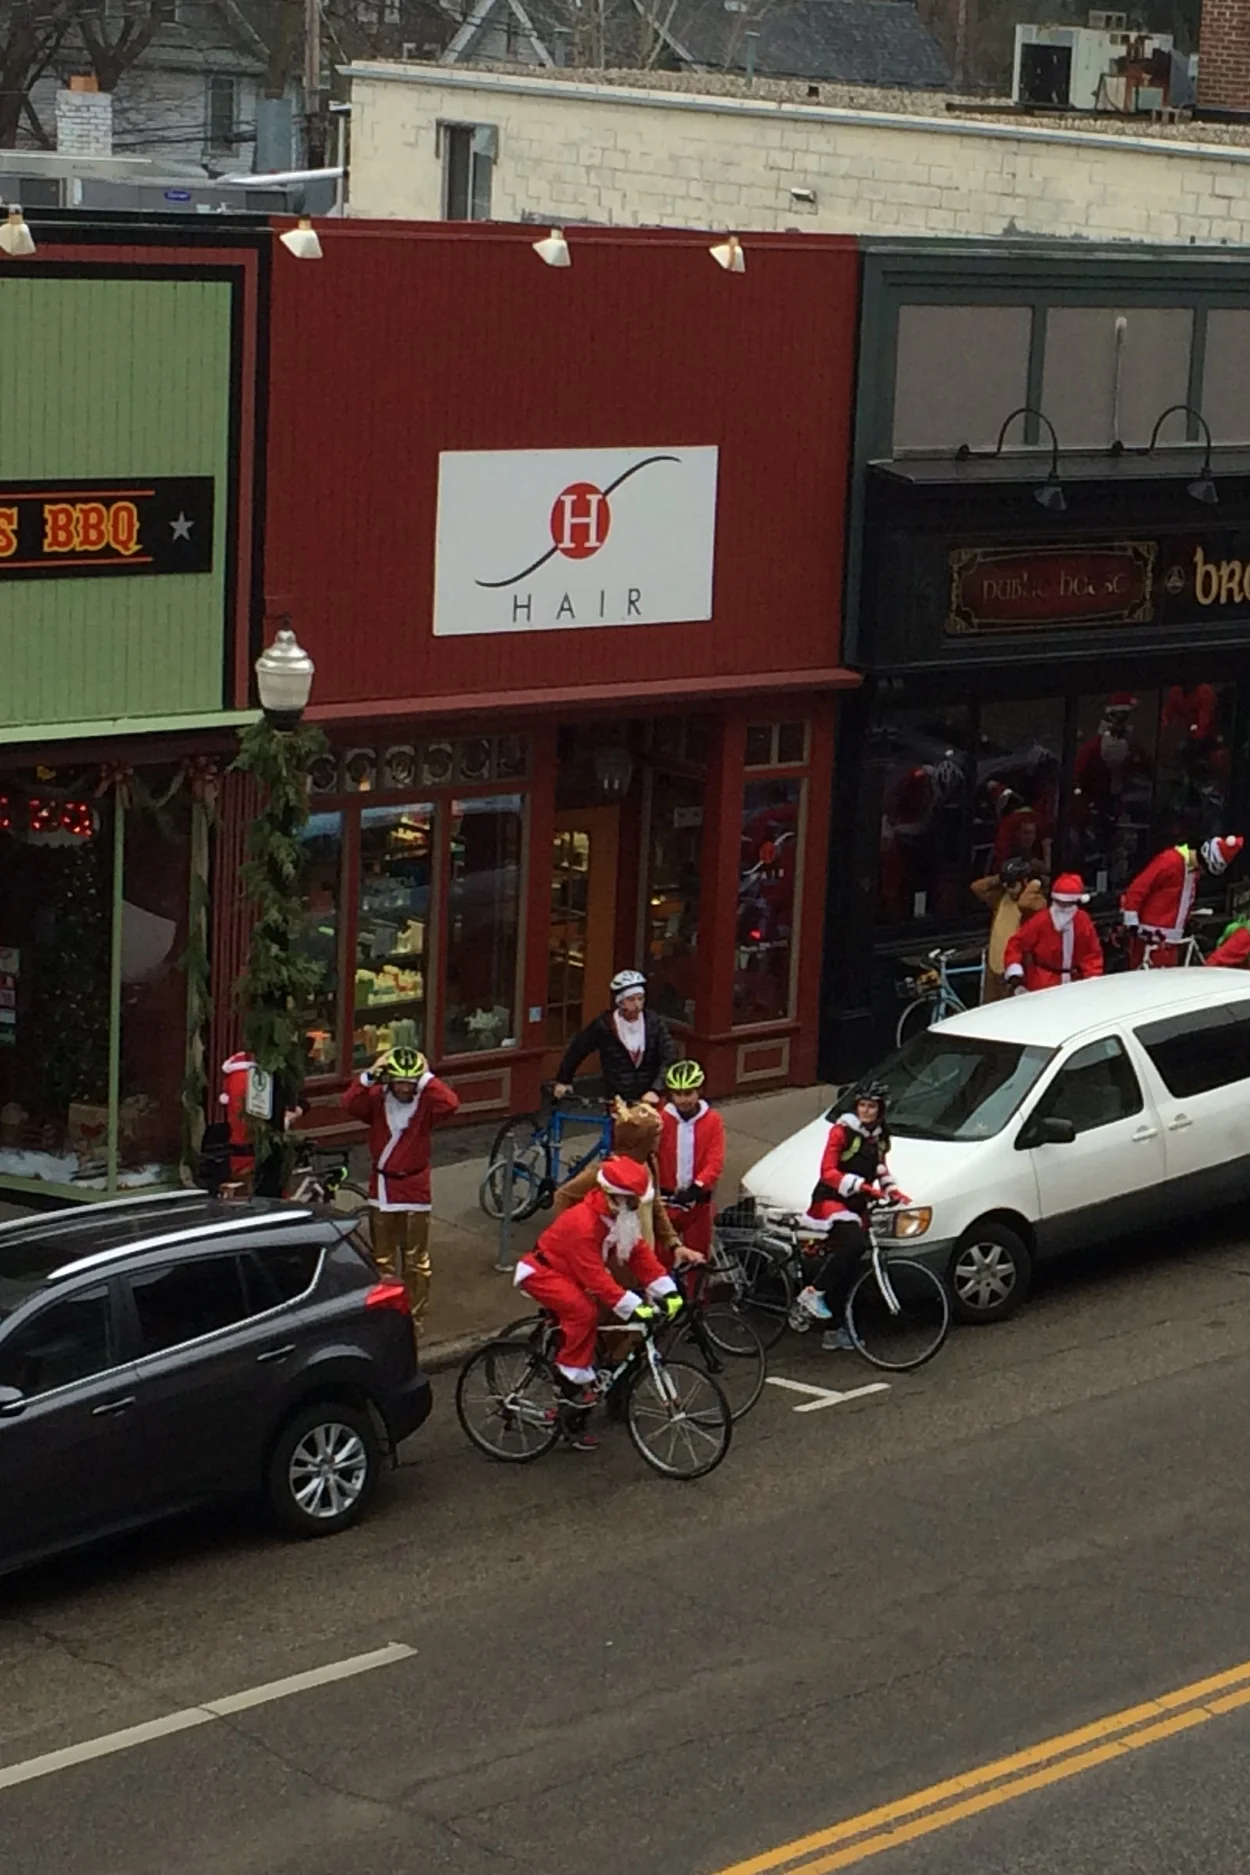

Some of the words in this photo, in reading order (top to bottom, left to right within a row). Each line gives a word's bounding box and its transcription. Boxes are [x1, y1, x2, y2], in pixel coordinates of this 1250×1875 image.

[43, 501, 142, 555] BBQ
[558, 493, 605, 548] H
[513, 588, 642, 622] HAIR
